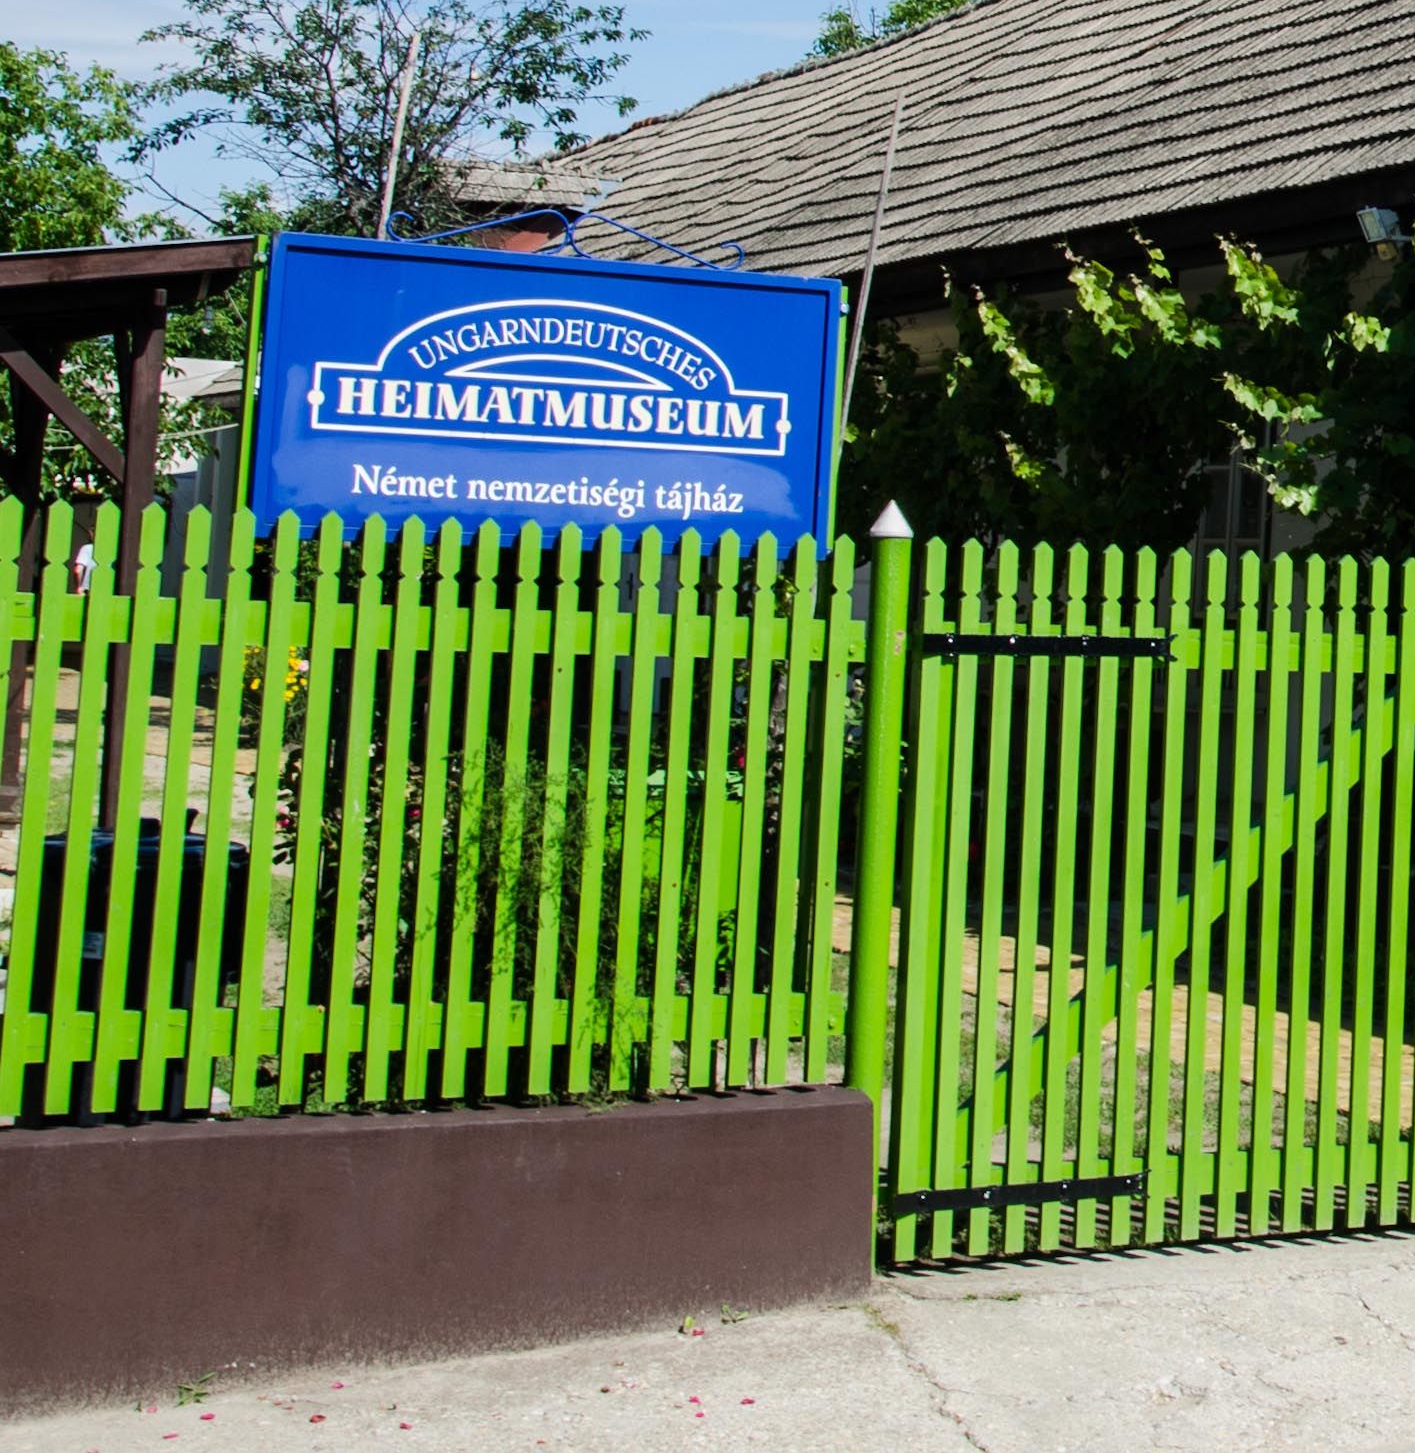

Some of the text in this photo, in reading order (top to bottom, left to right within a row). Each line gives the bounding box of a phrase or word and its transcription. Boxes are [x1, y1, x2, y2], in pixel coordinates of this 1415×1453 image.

[408, 317, 717, 391] UNGARNDEUTSCHES
[336, 376, 766, 440] HEIMATMUSEUM
[352, 464, 745, 521] Német nemzetiségi tájház
